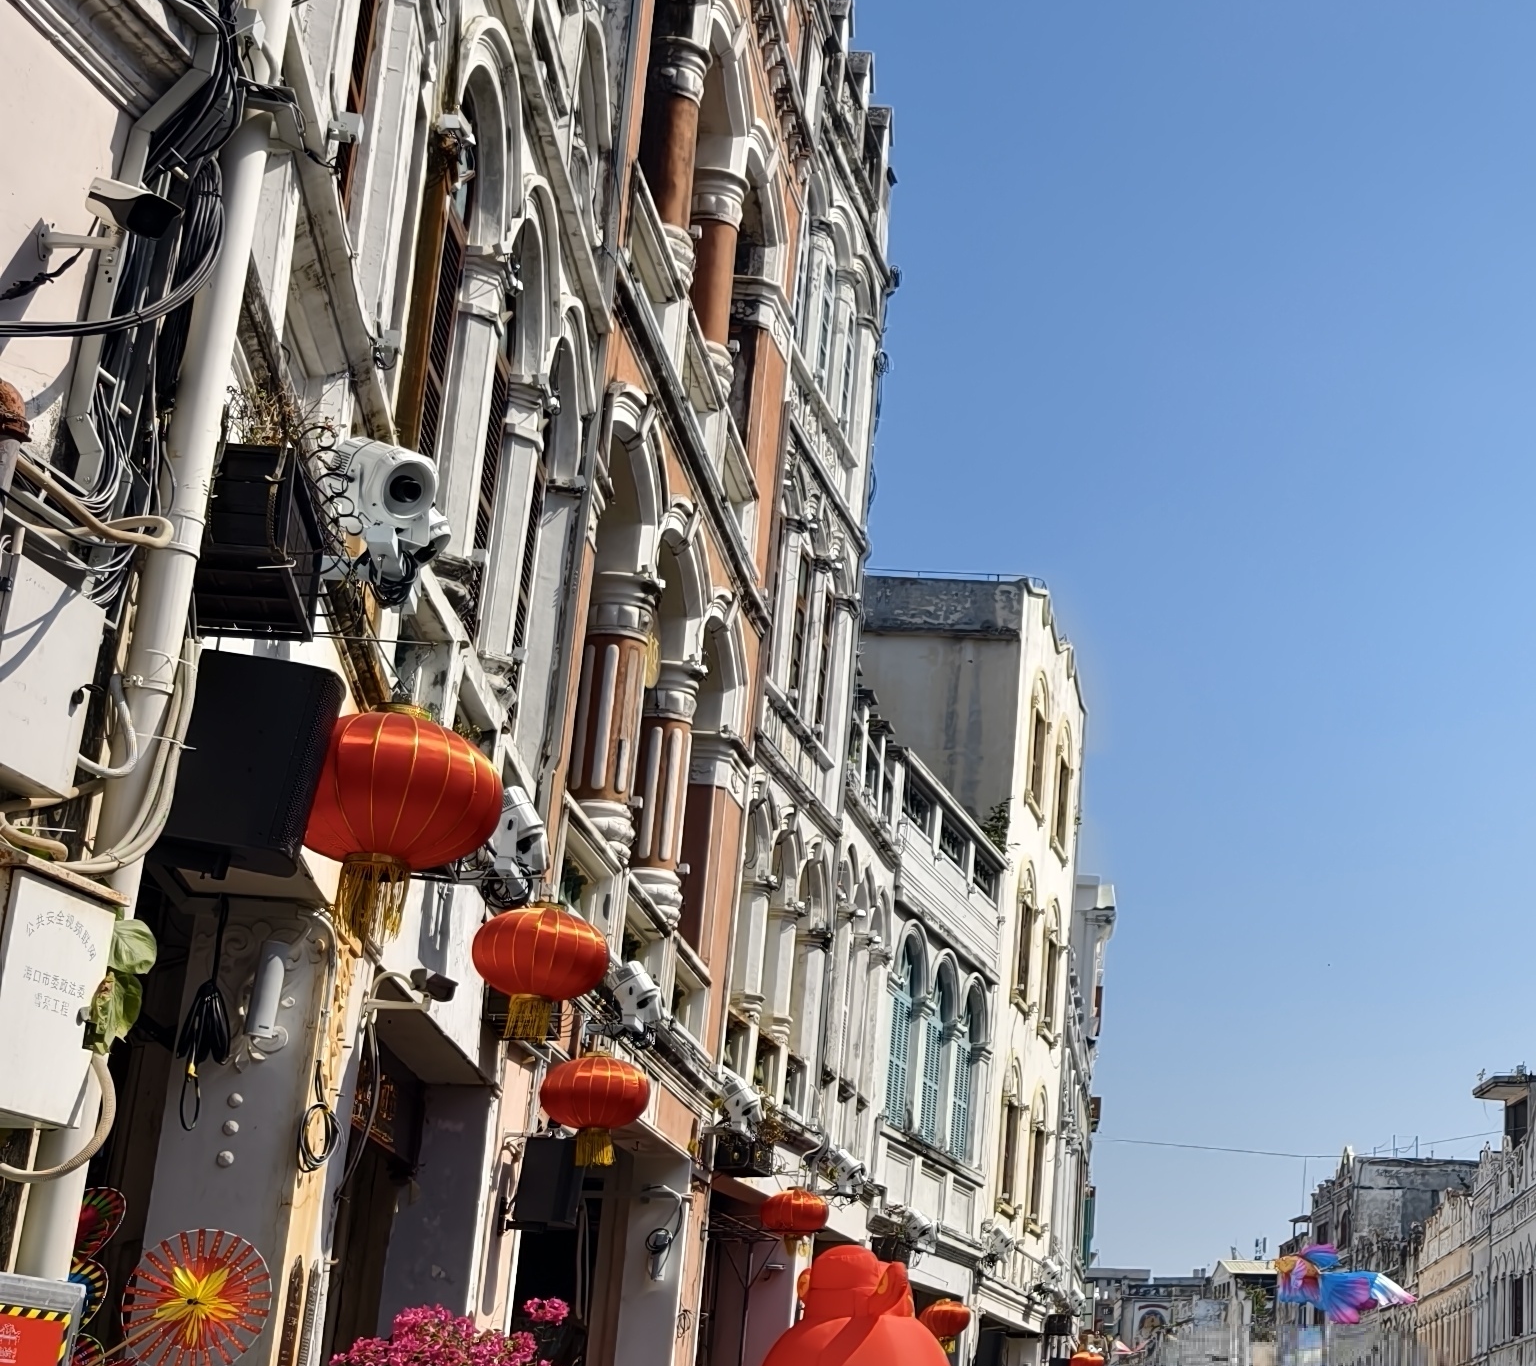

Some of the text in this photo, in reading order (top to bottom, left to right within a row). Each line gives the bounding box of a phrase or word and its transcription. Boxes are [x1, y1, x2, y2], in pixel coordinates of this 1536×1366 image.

[23, 965, 86, 1000] 海口市委政法委
